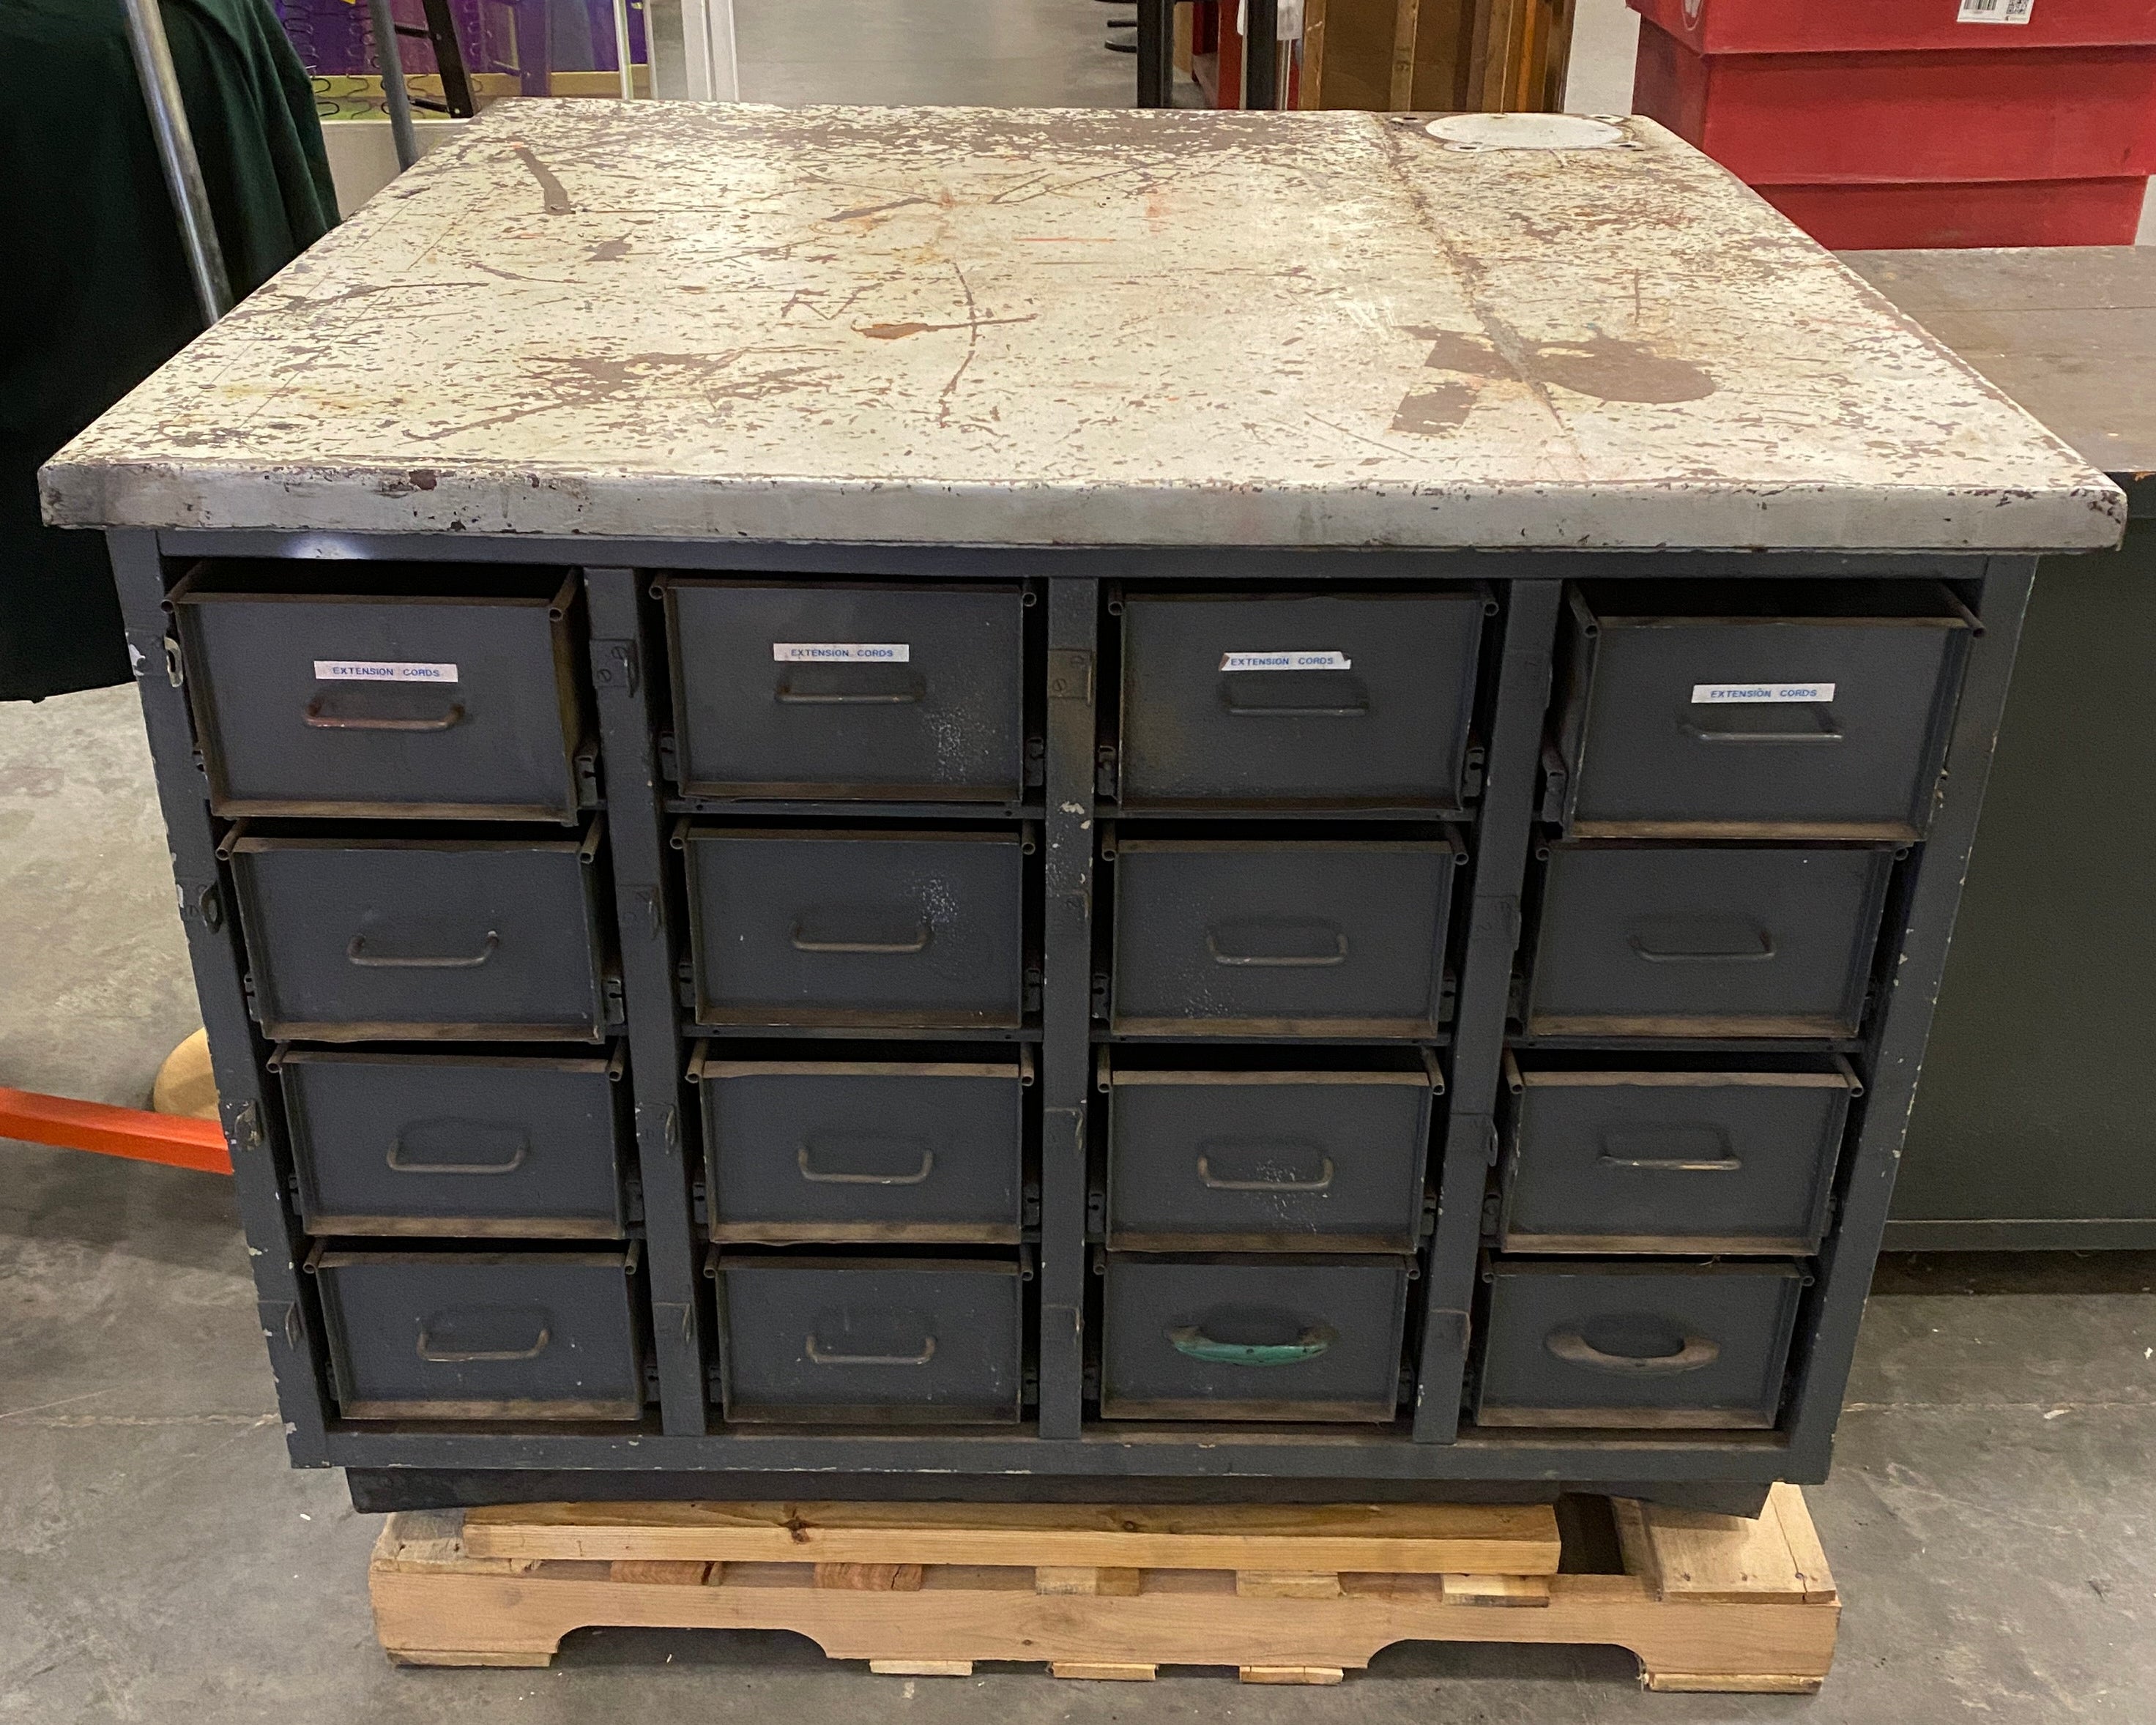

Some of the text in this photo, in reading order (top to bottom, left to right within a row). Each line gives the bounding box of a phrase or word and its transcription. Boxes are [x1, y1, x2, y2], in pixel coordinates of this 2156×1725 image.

[791, 649, 894, 657] EXTENSION CORDS
[1231, 657, 1334, 666] EXTENSION CORDS
[332, 666, 440, 677] EXTENSION CORDS
[1710, 689, 1818, 698] EXTENSION CORDS
